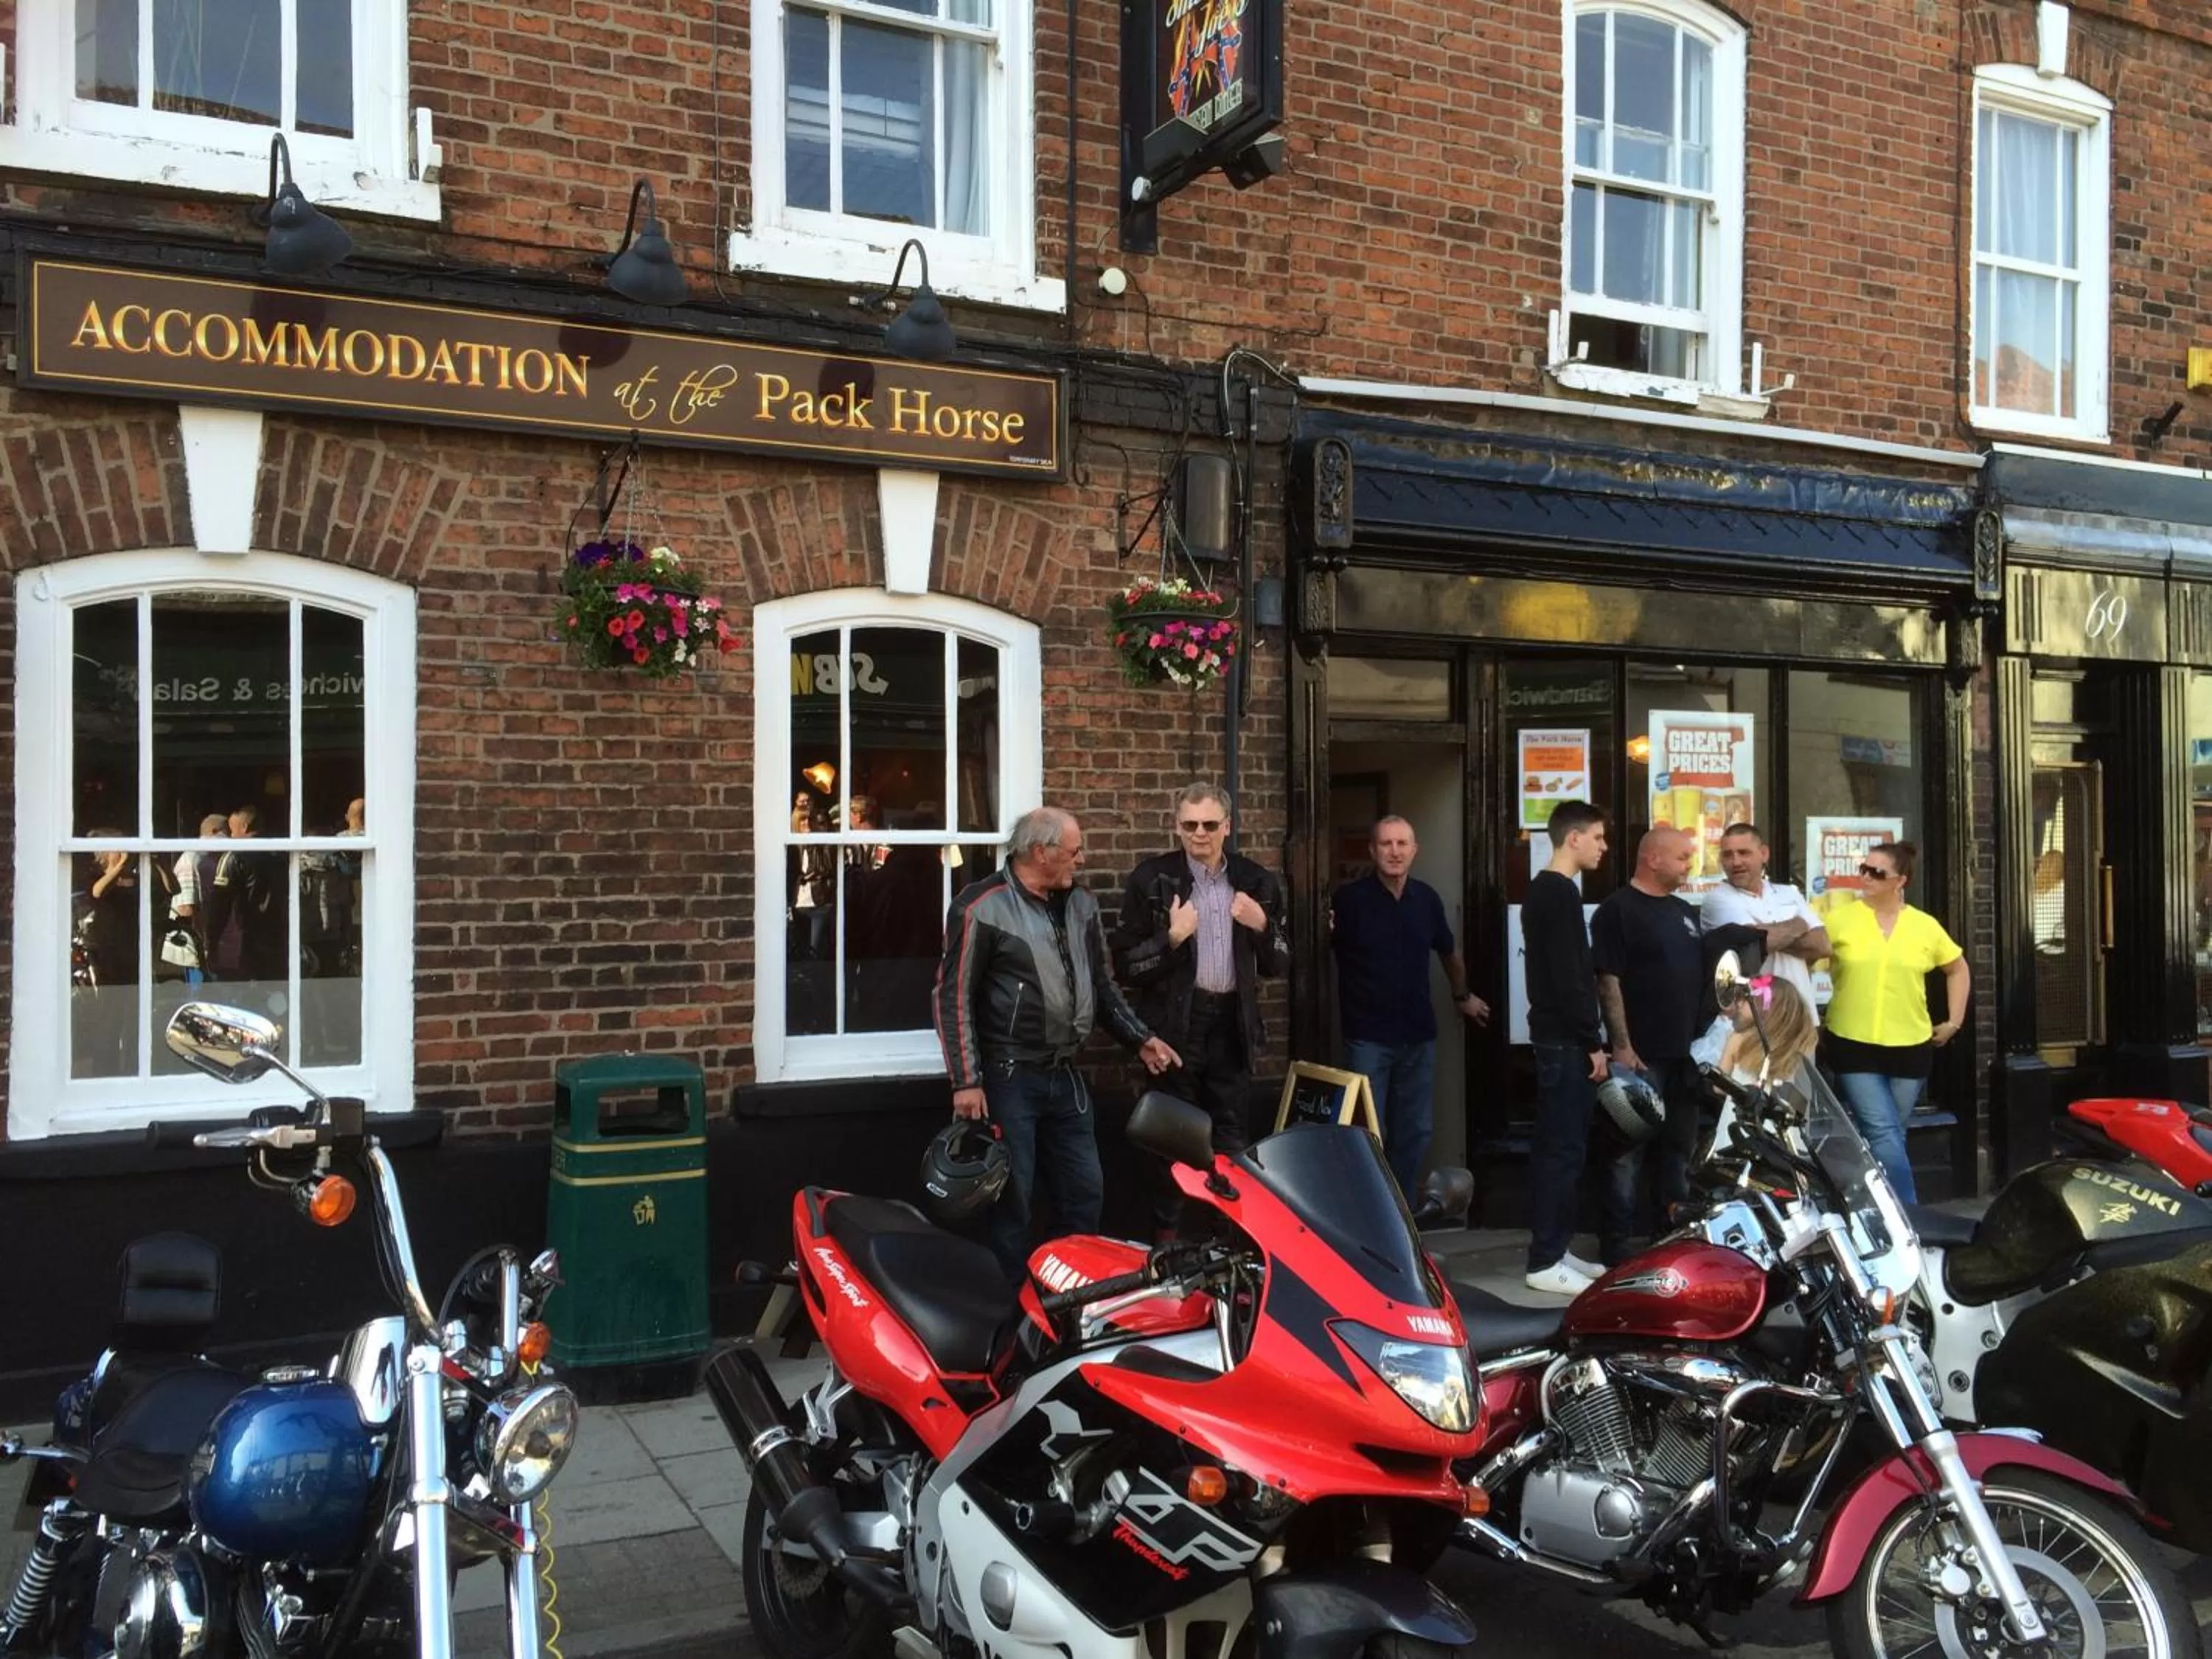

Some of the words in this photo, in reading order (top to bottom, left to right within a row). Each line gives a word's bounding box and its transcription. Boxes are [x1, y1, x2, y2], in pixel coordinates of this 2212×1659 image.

[70, 299, 589, 399] ACCOMMODATION
[613, 366, 656, 419] at
[669, 364, 738, 425] the
[754, 372, 874, 430] Pack
[888, 386, 1025, 444] Horse
[2084, 589, 2129, 644] 69
[1669, 731, 1731, 753] GREAT
[1669, 753, 1731, 774] PRICES
[1824, 858, 1861, 877] PRIC
[2071, 1167, 2183, 1216] SUZUKI
[1037, 1253, 1095, 1293] YAMA
[1406, 1315, 1455, 1336] YAMAHA
